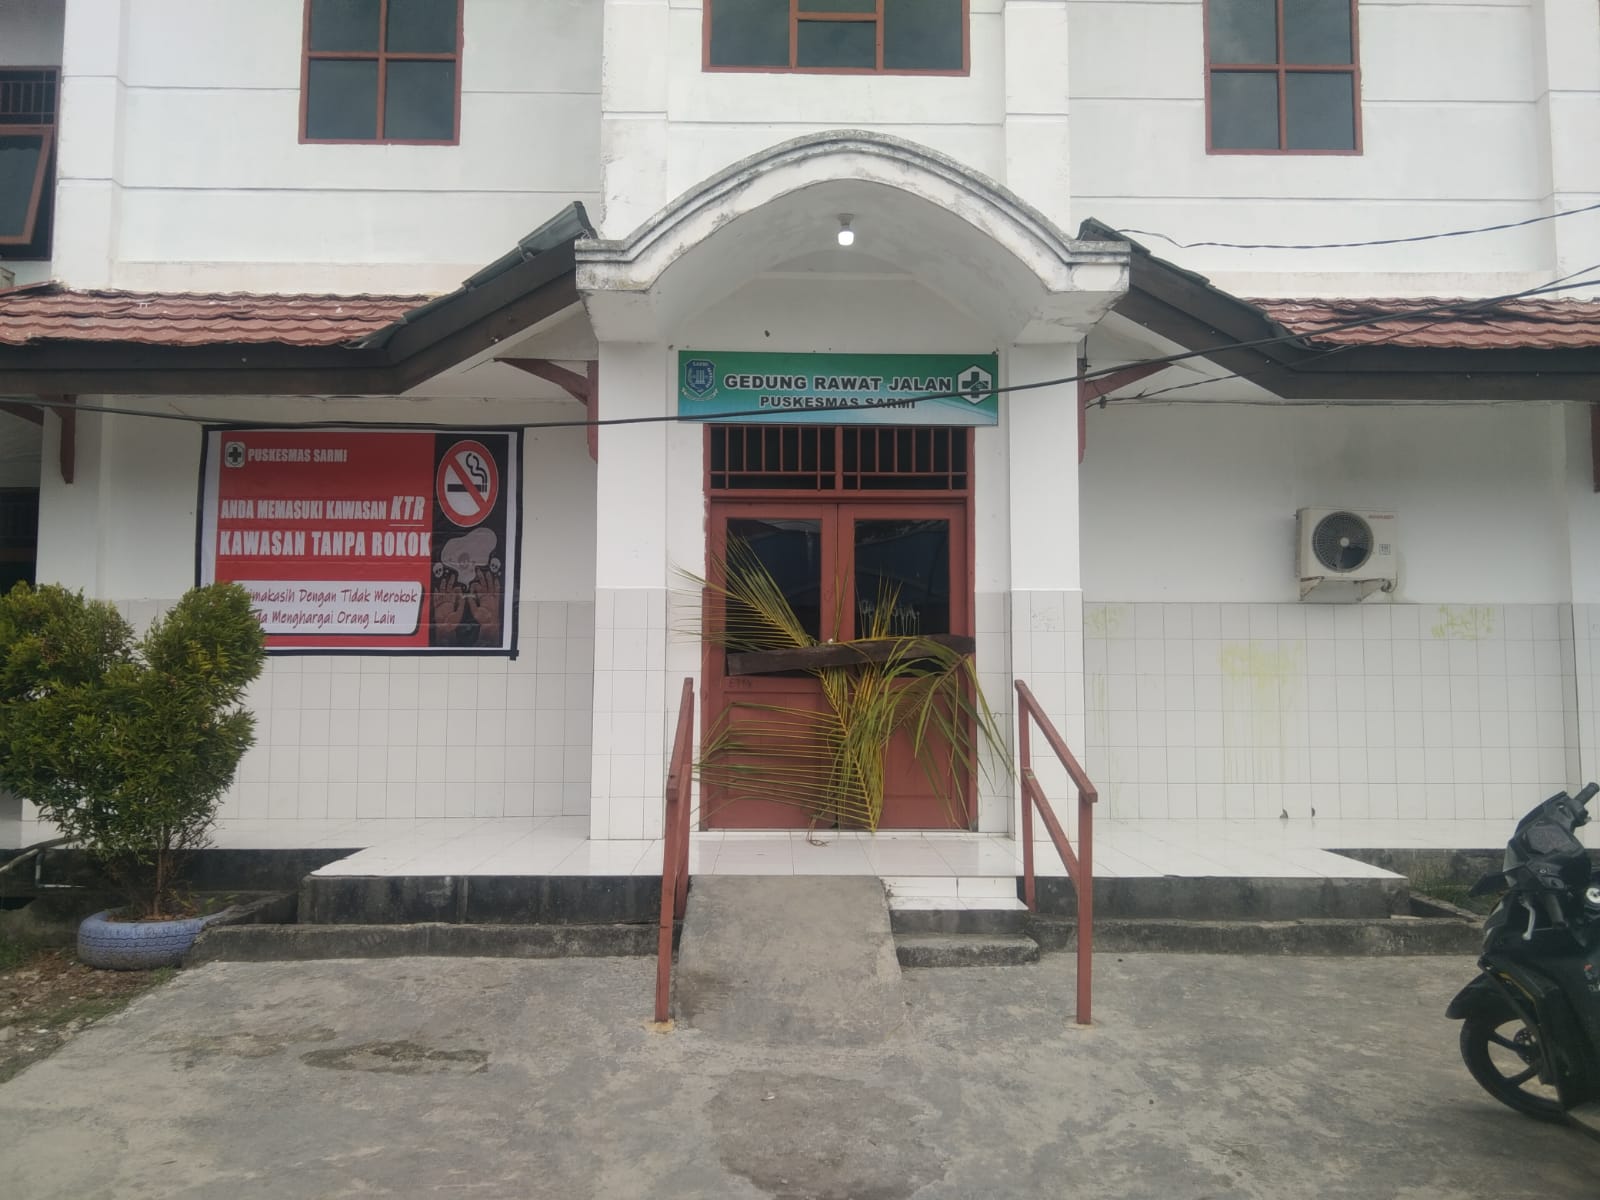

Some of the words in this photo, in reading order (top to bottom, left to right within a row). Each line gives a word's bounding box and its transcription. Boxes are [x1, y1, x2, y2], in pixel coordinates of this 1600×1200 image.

[724, 374, 808, 390] GEDUNG
[814, 376, 882, 391] RAWAT
[888, 377, 952, 392] JALAN
[759, 396, 859, 408] PUSKESMAS
[865, 397, 916, 409] SARMI
[247, 448, 312, 463] PUSKESMAS
[313, 449, 348, 463] SARMI
[221, 499, 254, 519] ANDA
[257, 499, 324, 520] MEMASUKI
[326, 500, 387, 520] KAWASAN
[390, 495, 426, 521] KTR
[219, 530, 306, 556] KAWASAN
[312, 531, 366, 557] TANPA
[371, 532, 431, 557] ROKOK
[249, 587, 295, 602] imakasih
[299, 588, 337, 608] Dengan
[340, 587, 371, 603] Tidak
[374, 588, 418, 603] Merokok
[272, 609, 334, 629] Menghargai
[337, 610, 370, 630] Orang
[373, 609, 396, 625] Lain
